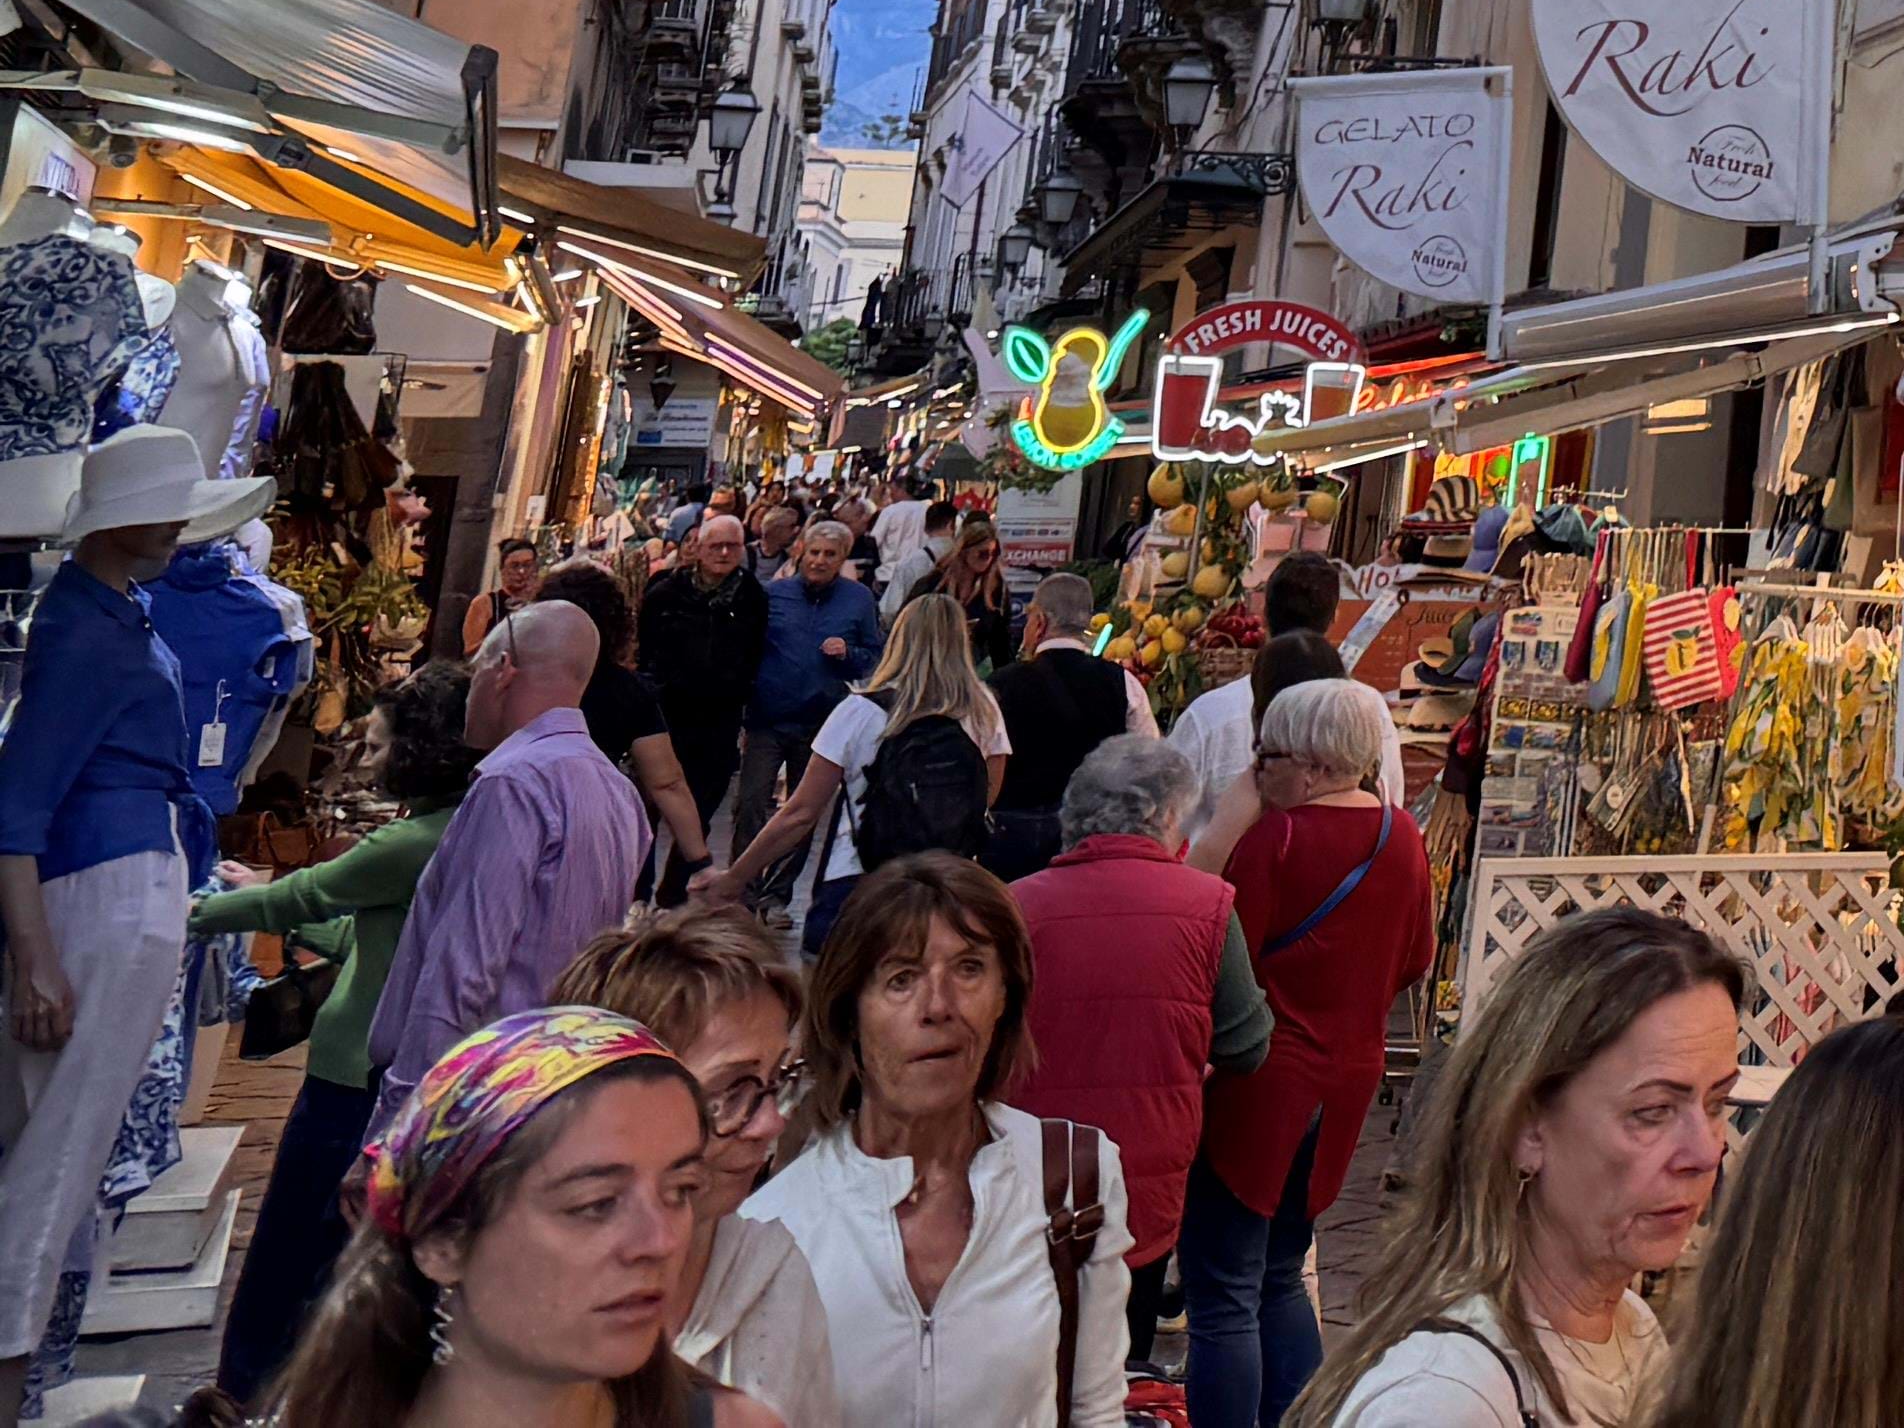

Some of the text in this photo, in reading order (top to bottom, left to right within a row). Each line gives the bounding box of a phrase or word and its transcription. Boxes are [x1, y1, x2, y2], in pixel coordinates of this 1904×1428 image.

[1314, 113, 1475, 144] GELATO
[1686, 145, 1774, 180] Natural
[1323, 140, 1474, 231] Raki
[1411, 248, 1468, 274] Natural
[1184, 308, 1348, 359] FRESH JUICES
